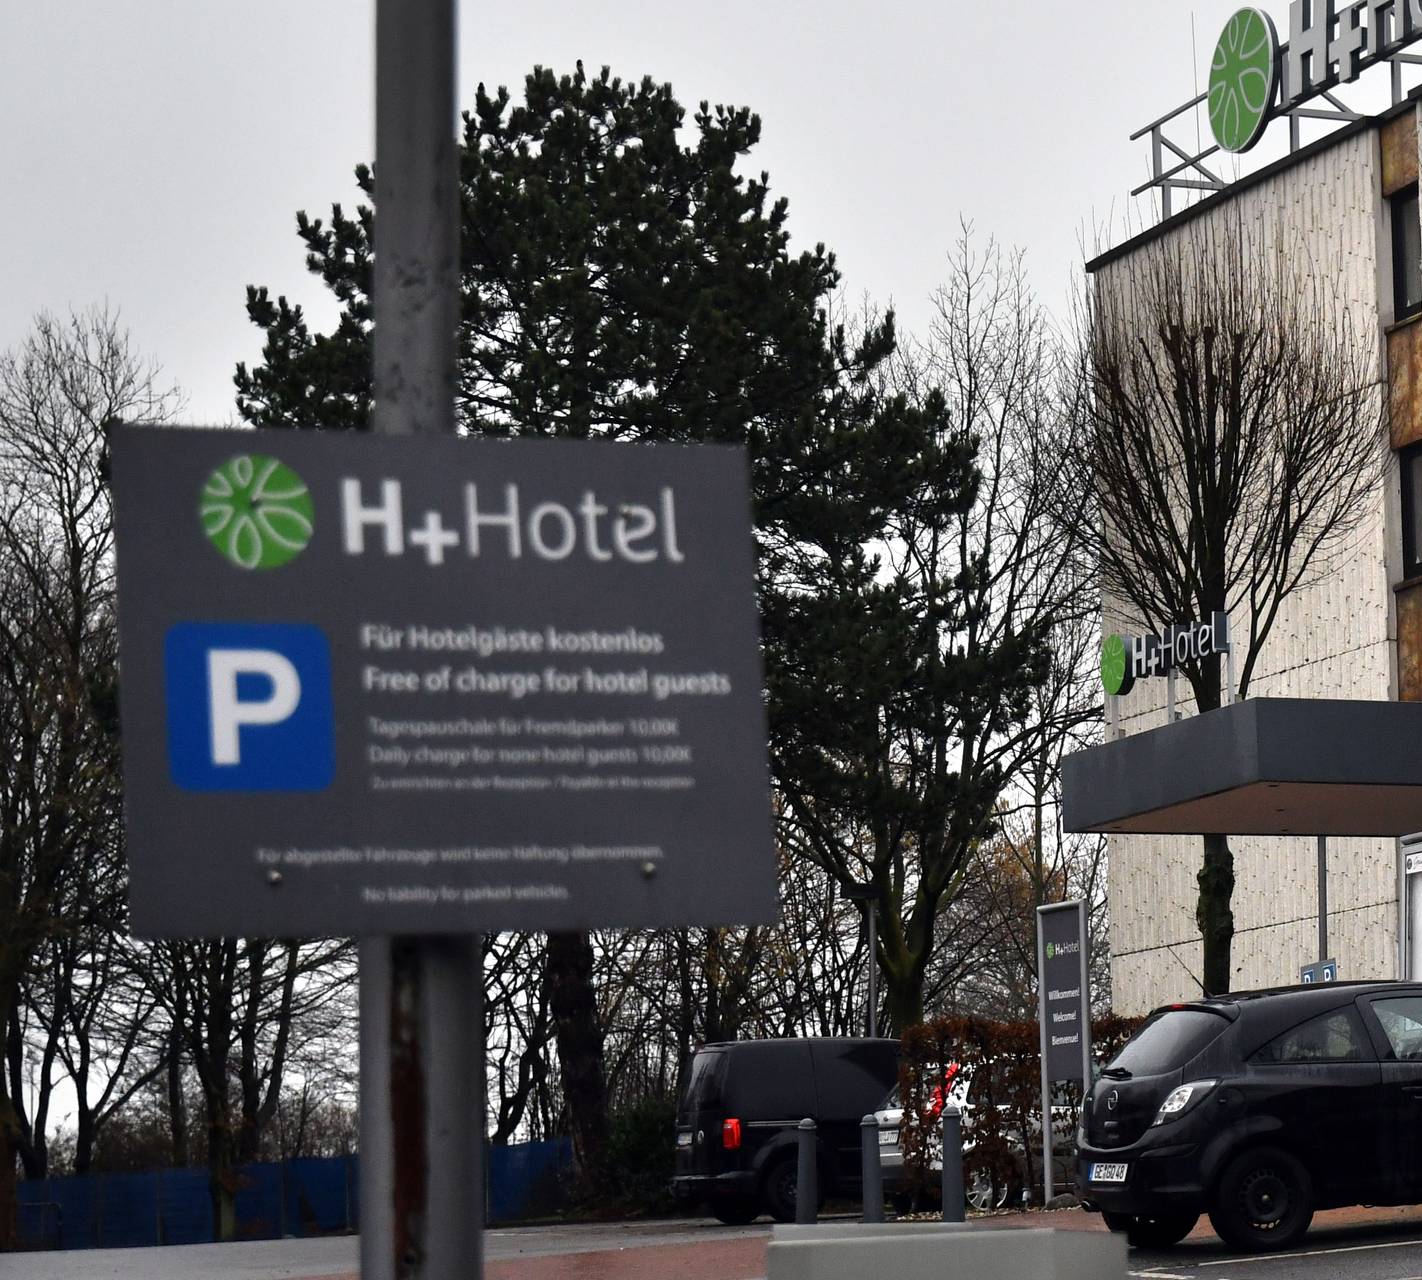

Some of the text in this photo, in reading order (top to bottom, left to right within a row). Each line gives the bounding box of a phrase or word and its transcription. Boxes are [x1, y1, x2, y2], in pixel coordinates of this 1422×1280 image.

[340, 477, 685, 566] H+Hotel
[363, 624, 665, 657] Für Hotelgäste kostenlos
[1132, 611, 1217, 678] H+Hotel
[364, 666, 732, 700] Free of charge for hotel guests
[207, 648, 301, 767] P
[368, 745, 411, 768] Daily
[413, 746, 470, 768] charge
[472, 746, 495, 765] for
[586, 748, 639, 768] guests
[1055, 940, 1080, 956] H+Hotel
